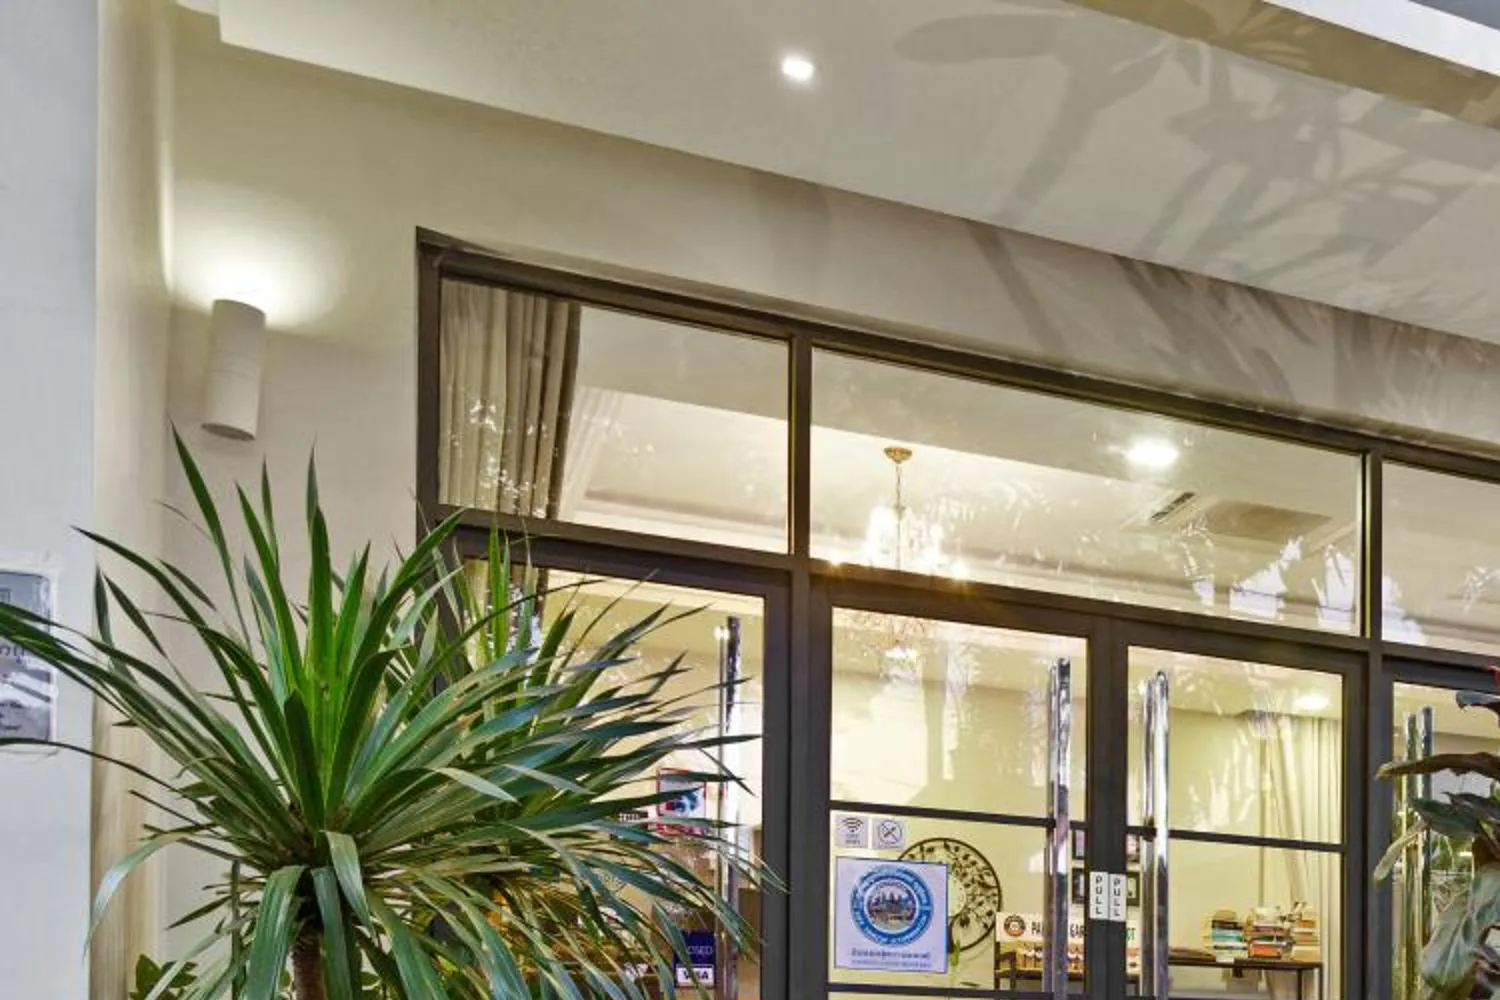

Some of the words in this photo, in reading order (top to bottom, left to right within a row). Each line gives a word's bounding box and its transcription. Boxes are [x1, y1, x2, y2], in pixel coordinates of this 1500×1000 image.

[1095, 875, 1103, 915] PULL
[1113, 878, 1121, 917] PULL
[683, 970, 709, 980] VSA
